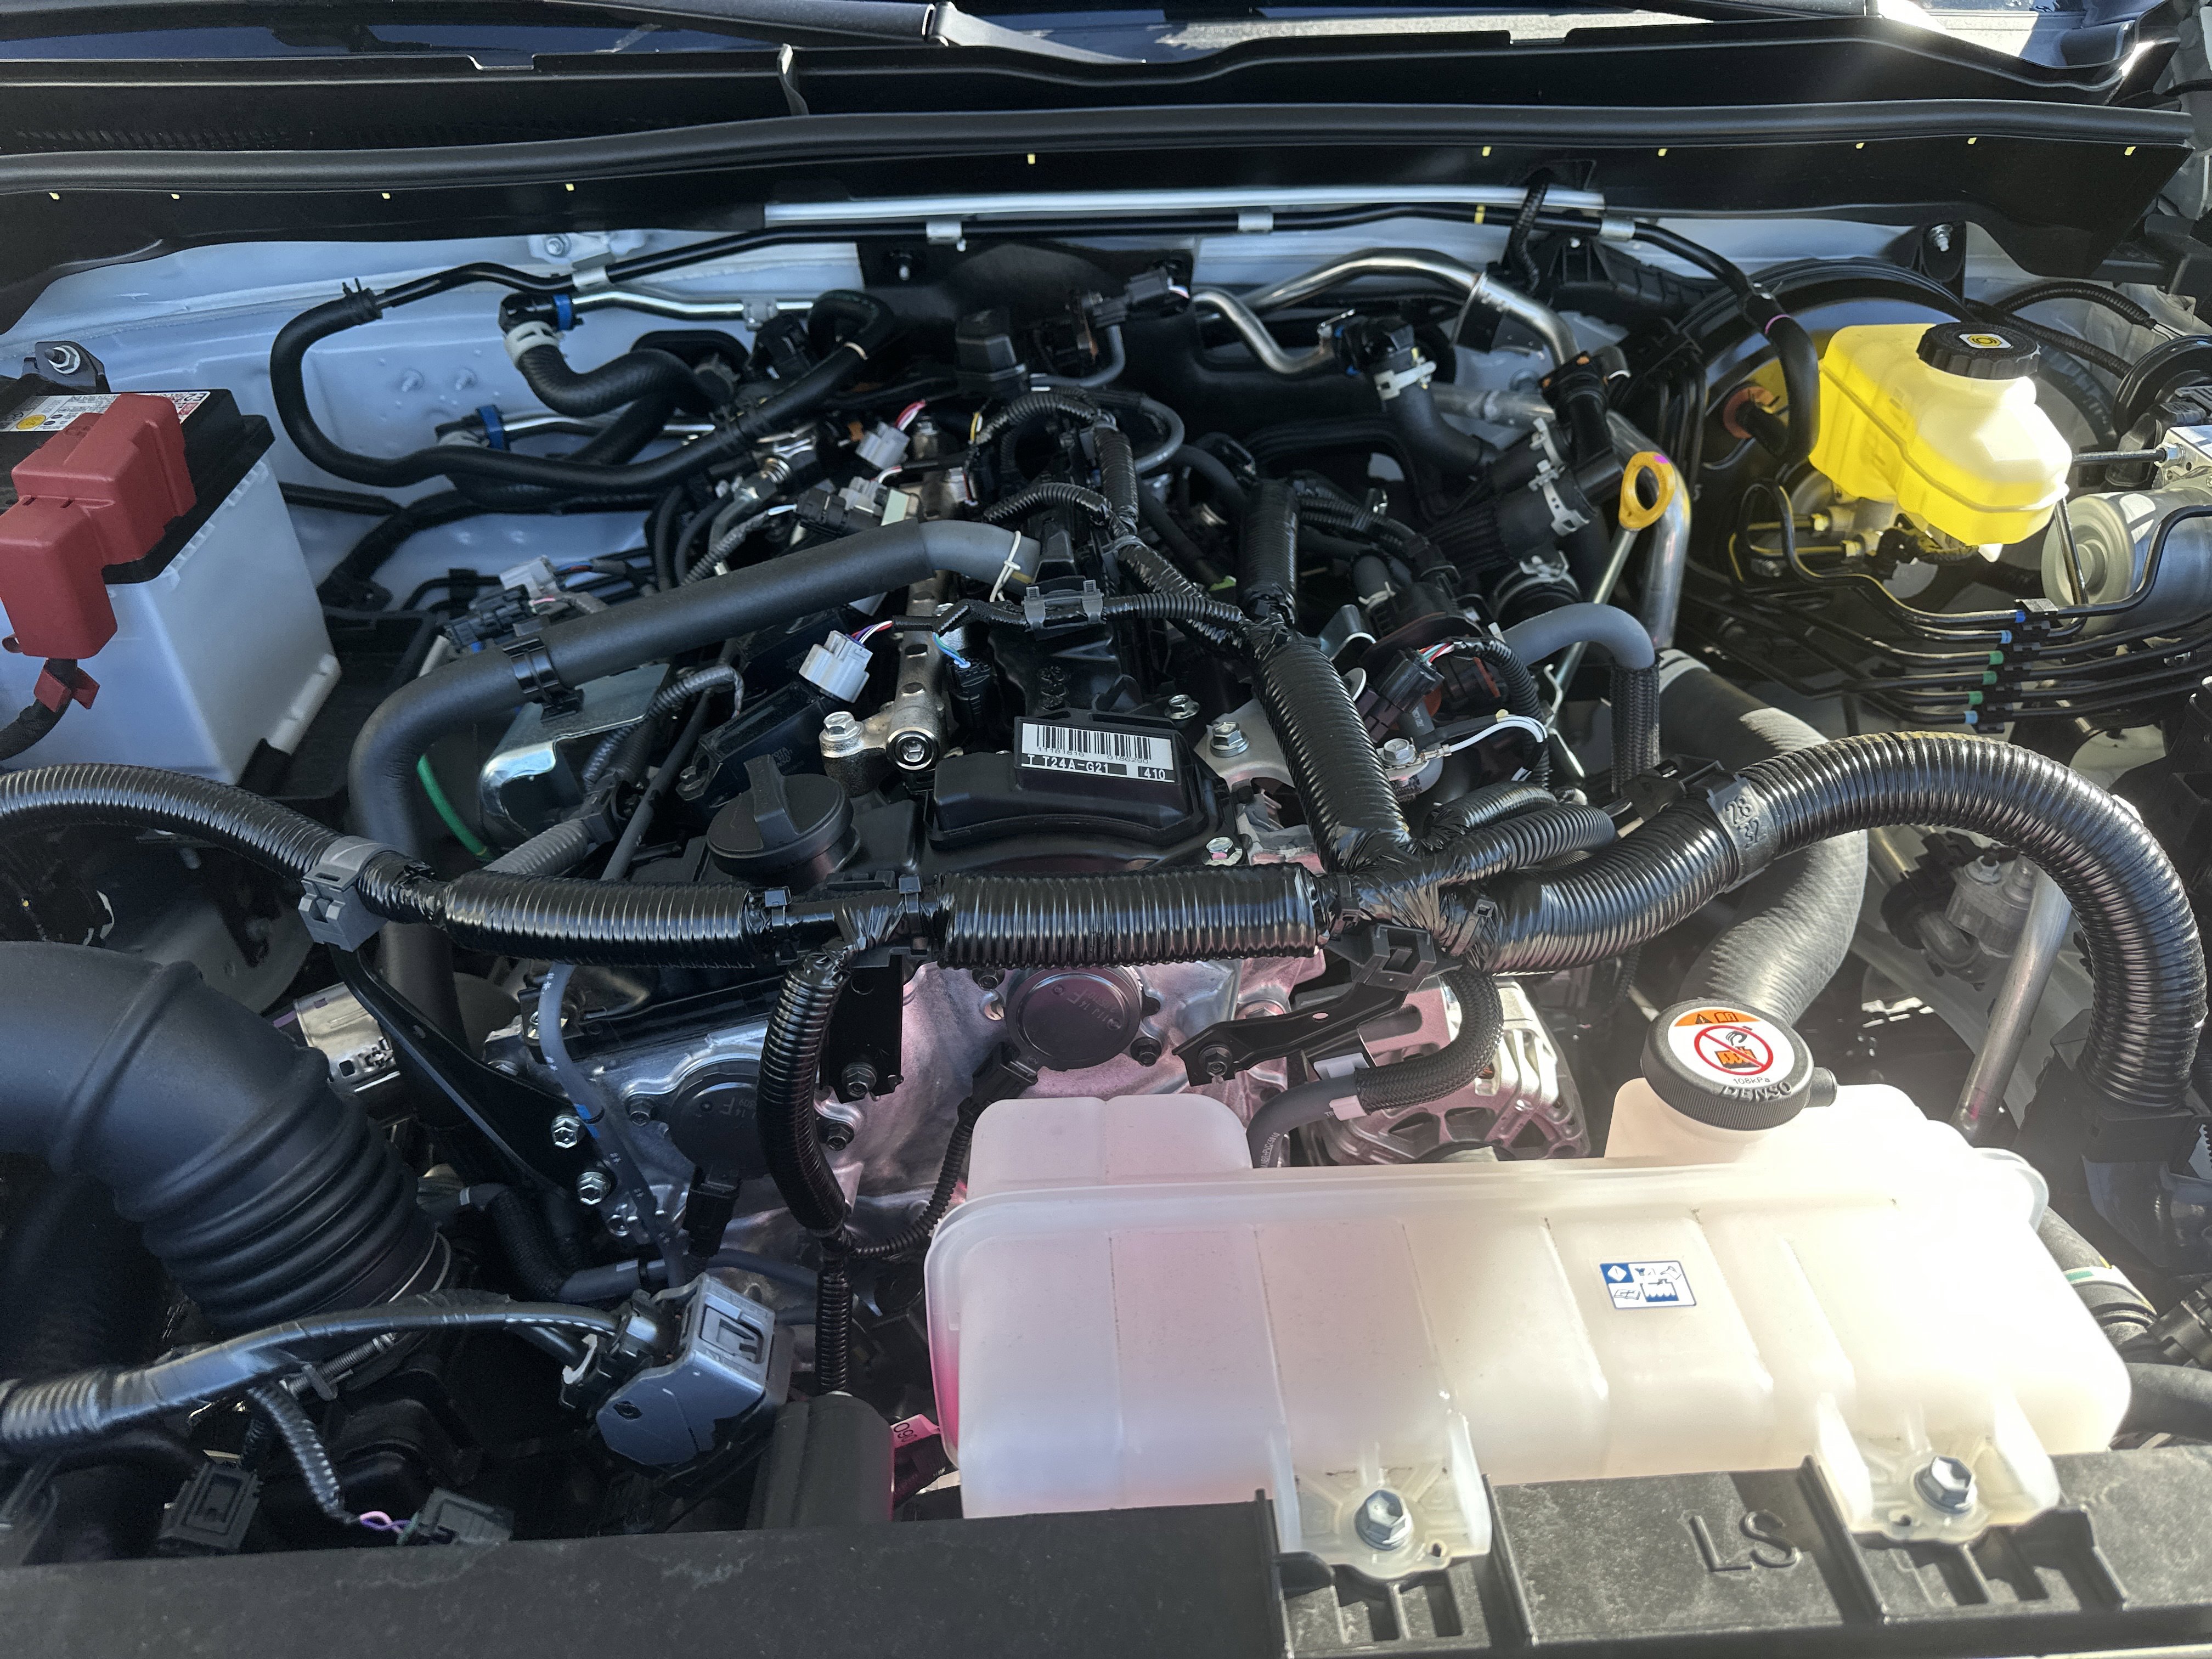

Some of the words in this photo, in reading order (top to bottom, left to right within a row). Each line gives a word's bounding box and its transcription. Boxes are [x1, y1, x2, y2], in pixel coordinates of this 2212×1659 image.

[1028, 754, 1035, 765] T
[1042, 755, 1109, 774] T24A-G21
[1144, 769, 1166, 781] 410
[1724, 794, 1753, 825] 28
[1737, 816, 1767, 848] 32
[1719, 1082, 1792, 1103] DENSO
[1733, 1077, 1771, 1086] 108kPa
[1688, 1509, 1802, 1573] LS
